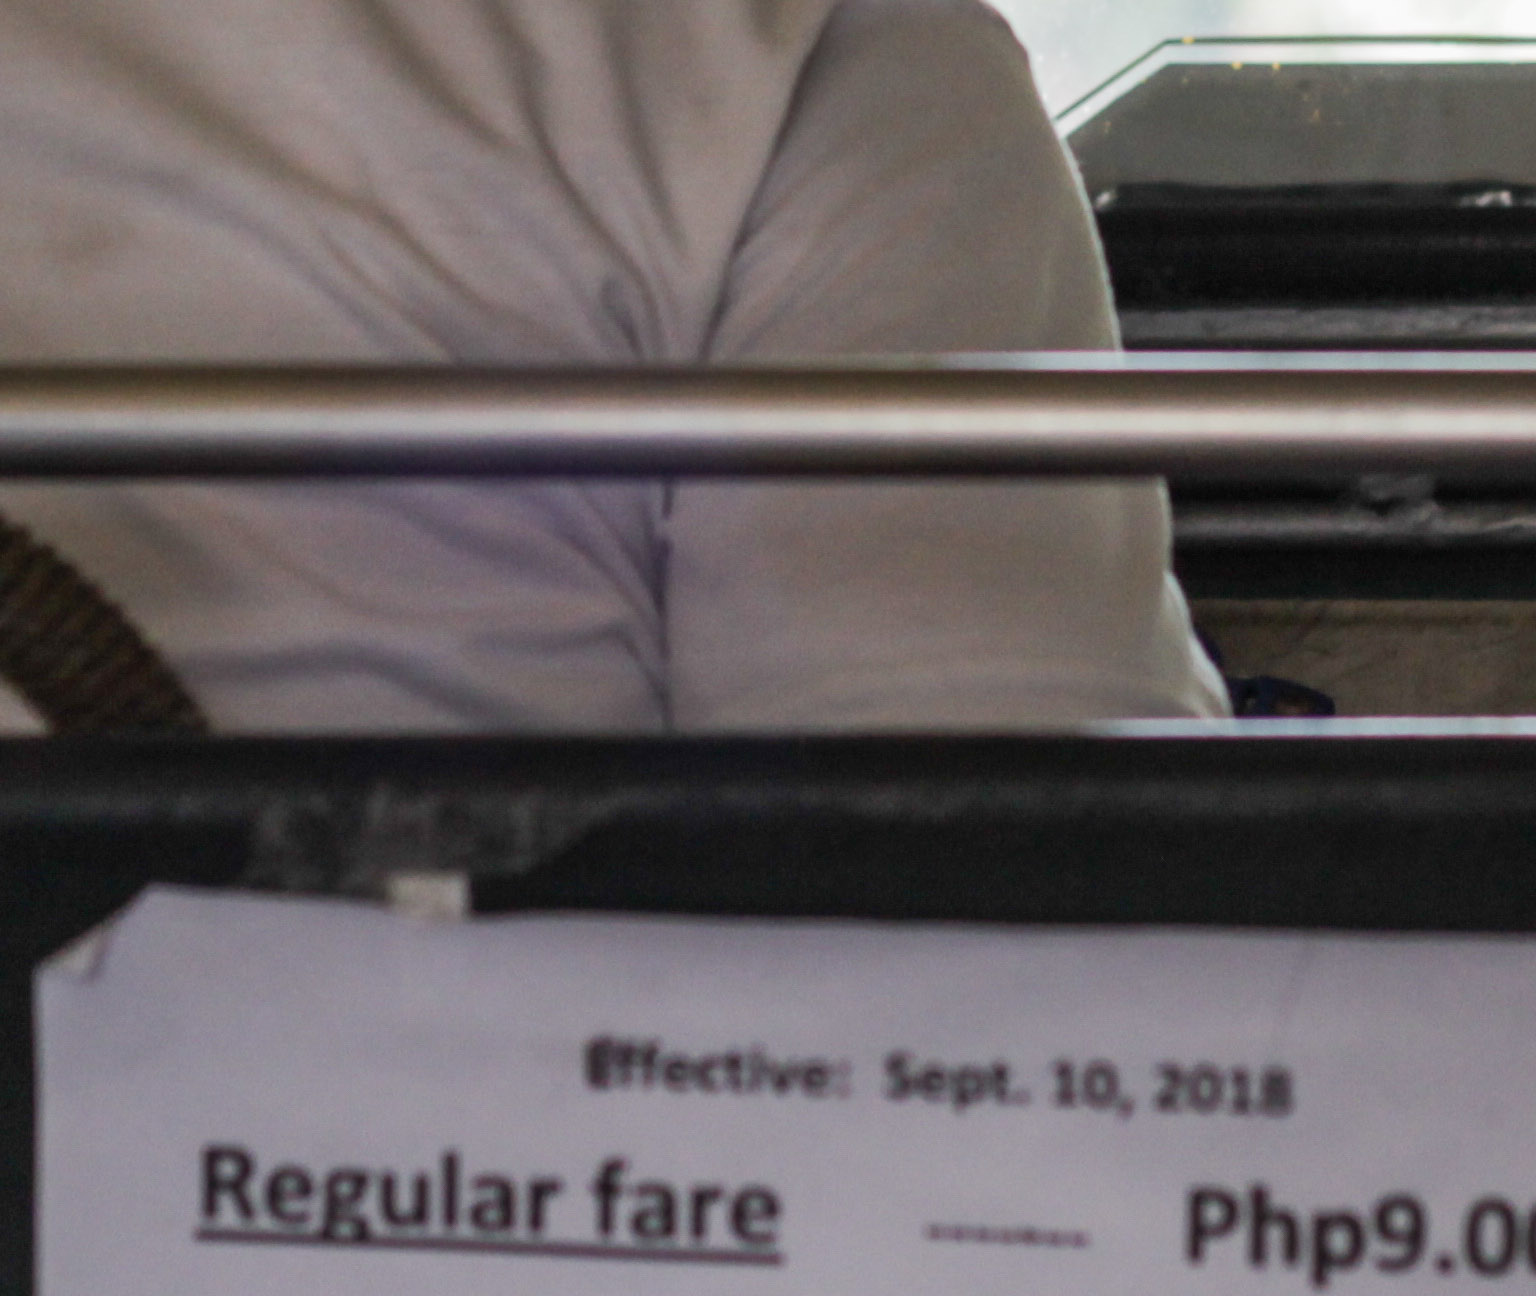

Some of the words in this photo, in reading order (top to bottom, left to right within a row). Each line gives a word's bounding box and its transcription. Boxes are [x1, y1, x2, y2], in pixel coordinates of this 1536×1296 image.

[584, 1036, 852, 1098] Effective:
[885, 1051, 1030, 1110] Sept.
[1052, 1059, 1135, 1117] 10,
[1153, 1062, 1294, 1116] 2018
[200, 1144, 562, 1240] Regular
[592, 1157, 784, 1246] fare
